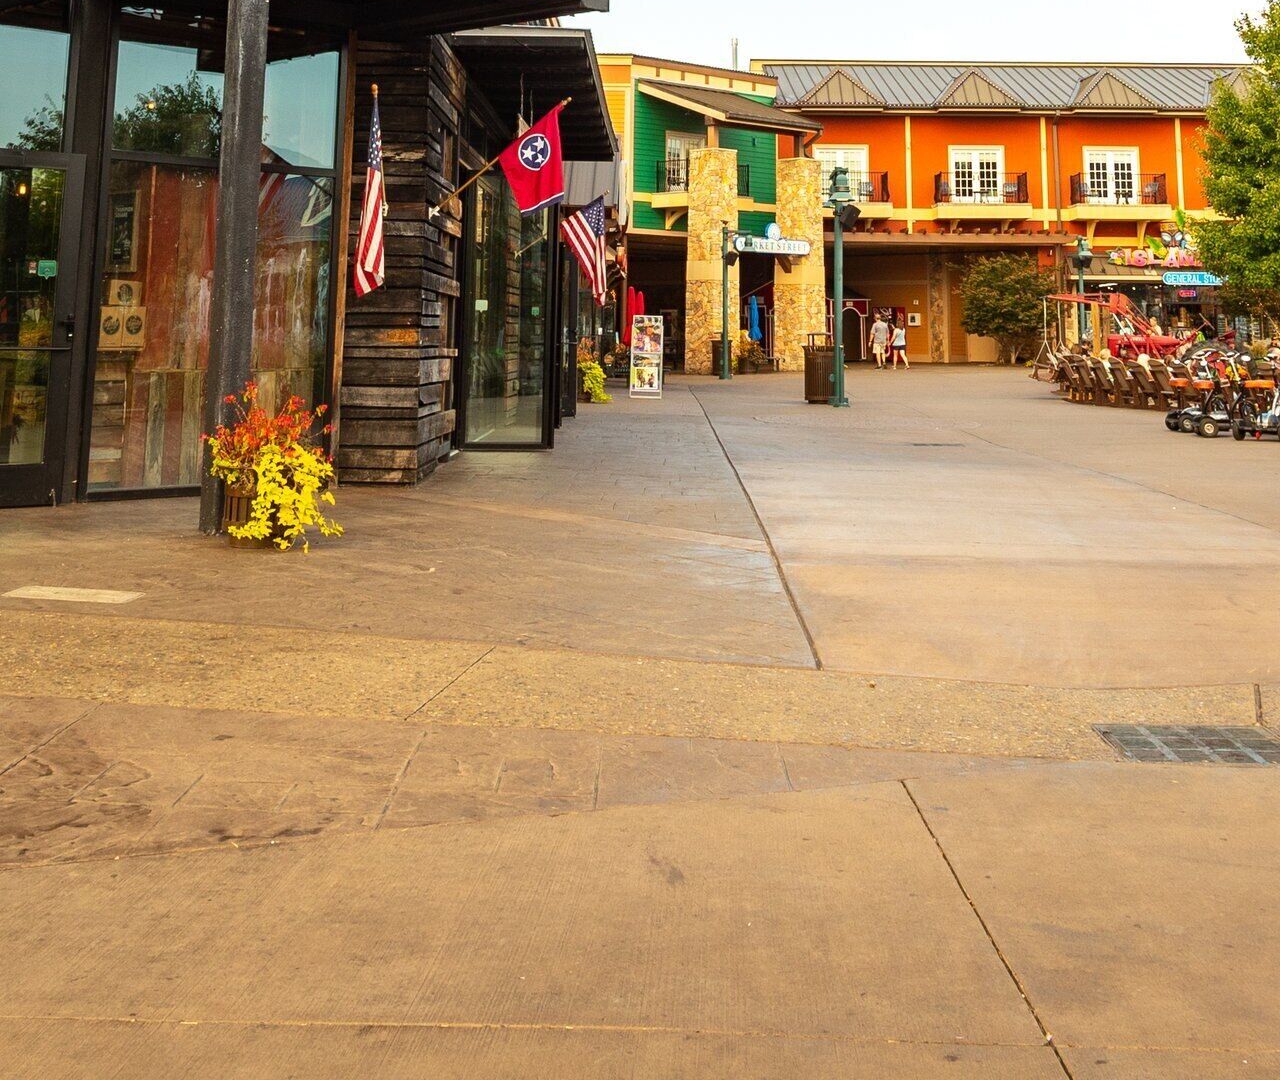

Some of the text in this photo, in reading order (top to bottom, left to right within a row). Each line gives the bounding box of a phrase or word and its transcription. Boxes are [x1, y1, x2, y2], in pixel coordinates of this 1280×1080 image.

[776, 240, 807, 252] STREET
[1124, 245, 1203, 269] ISLAN
[1165, 272, 1202, 284] GENERAL
